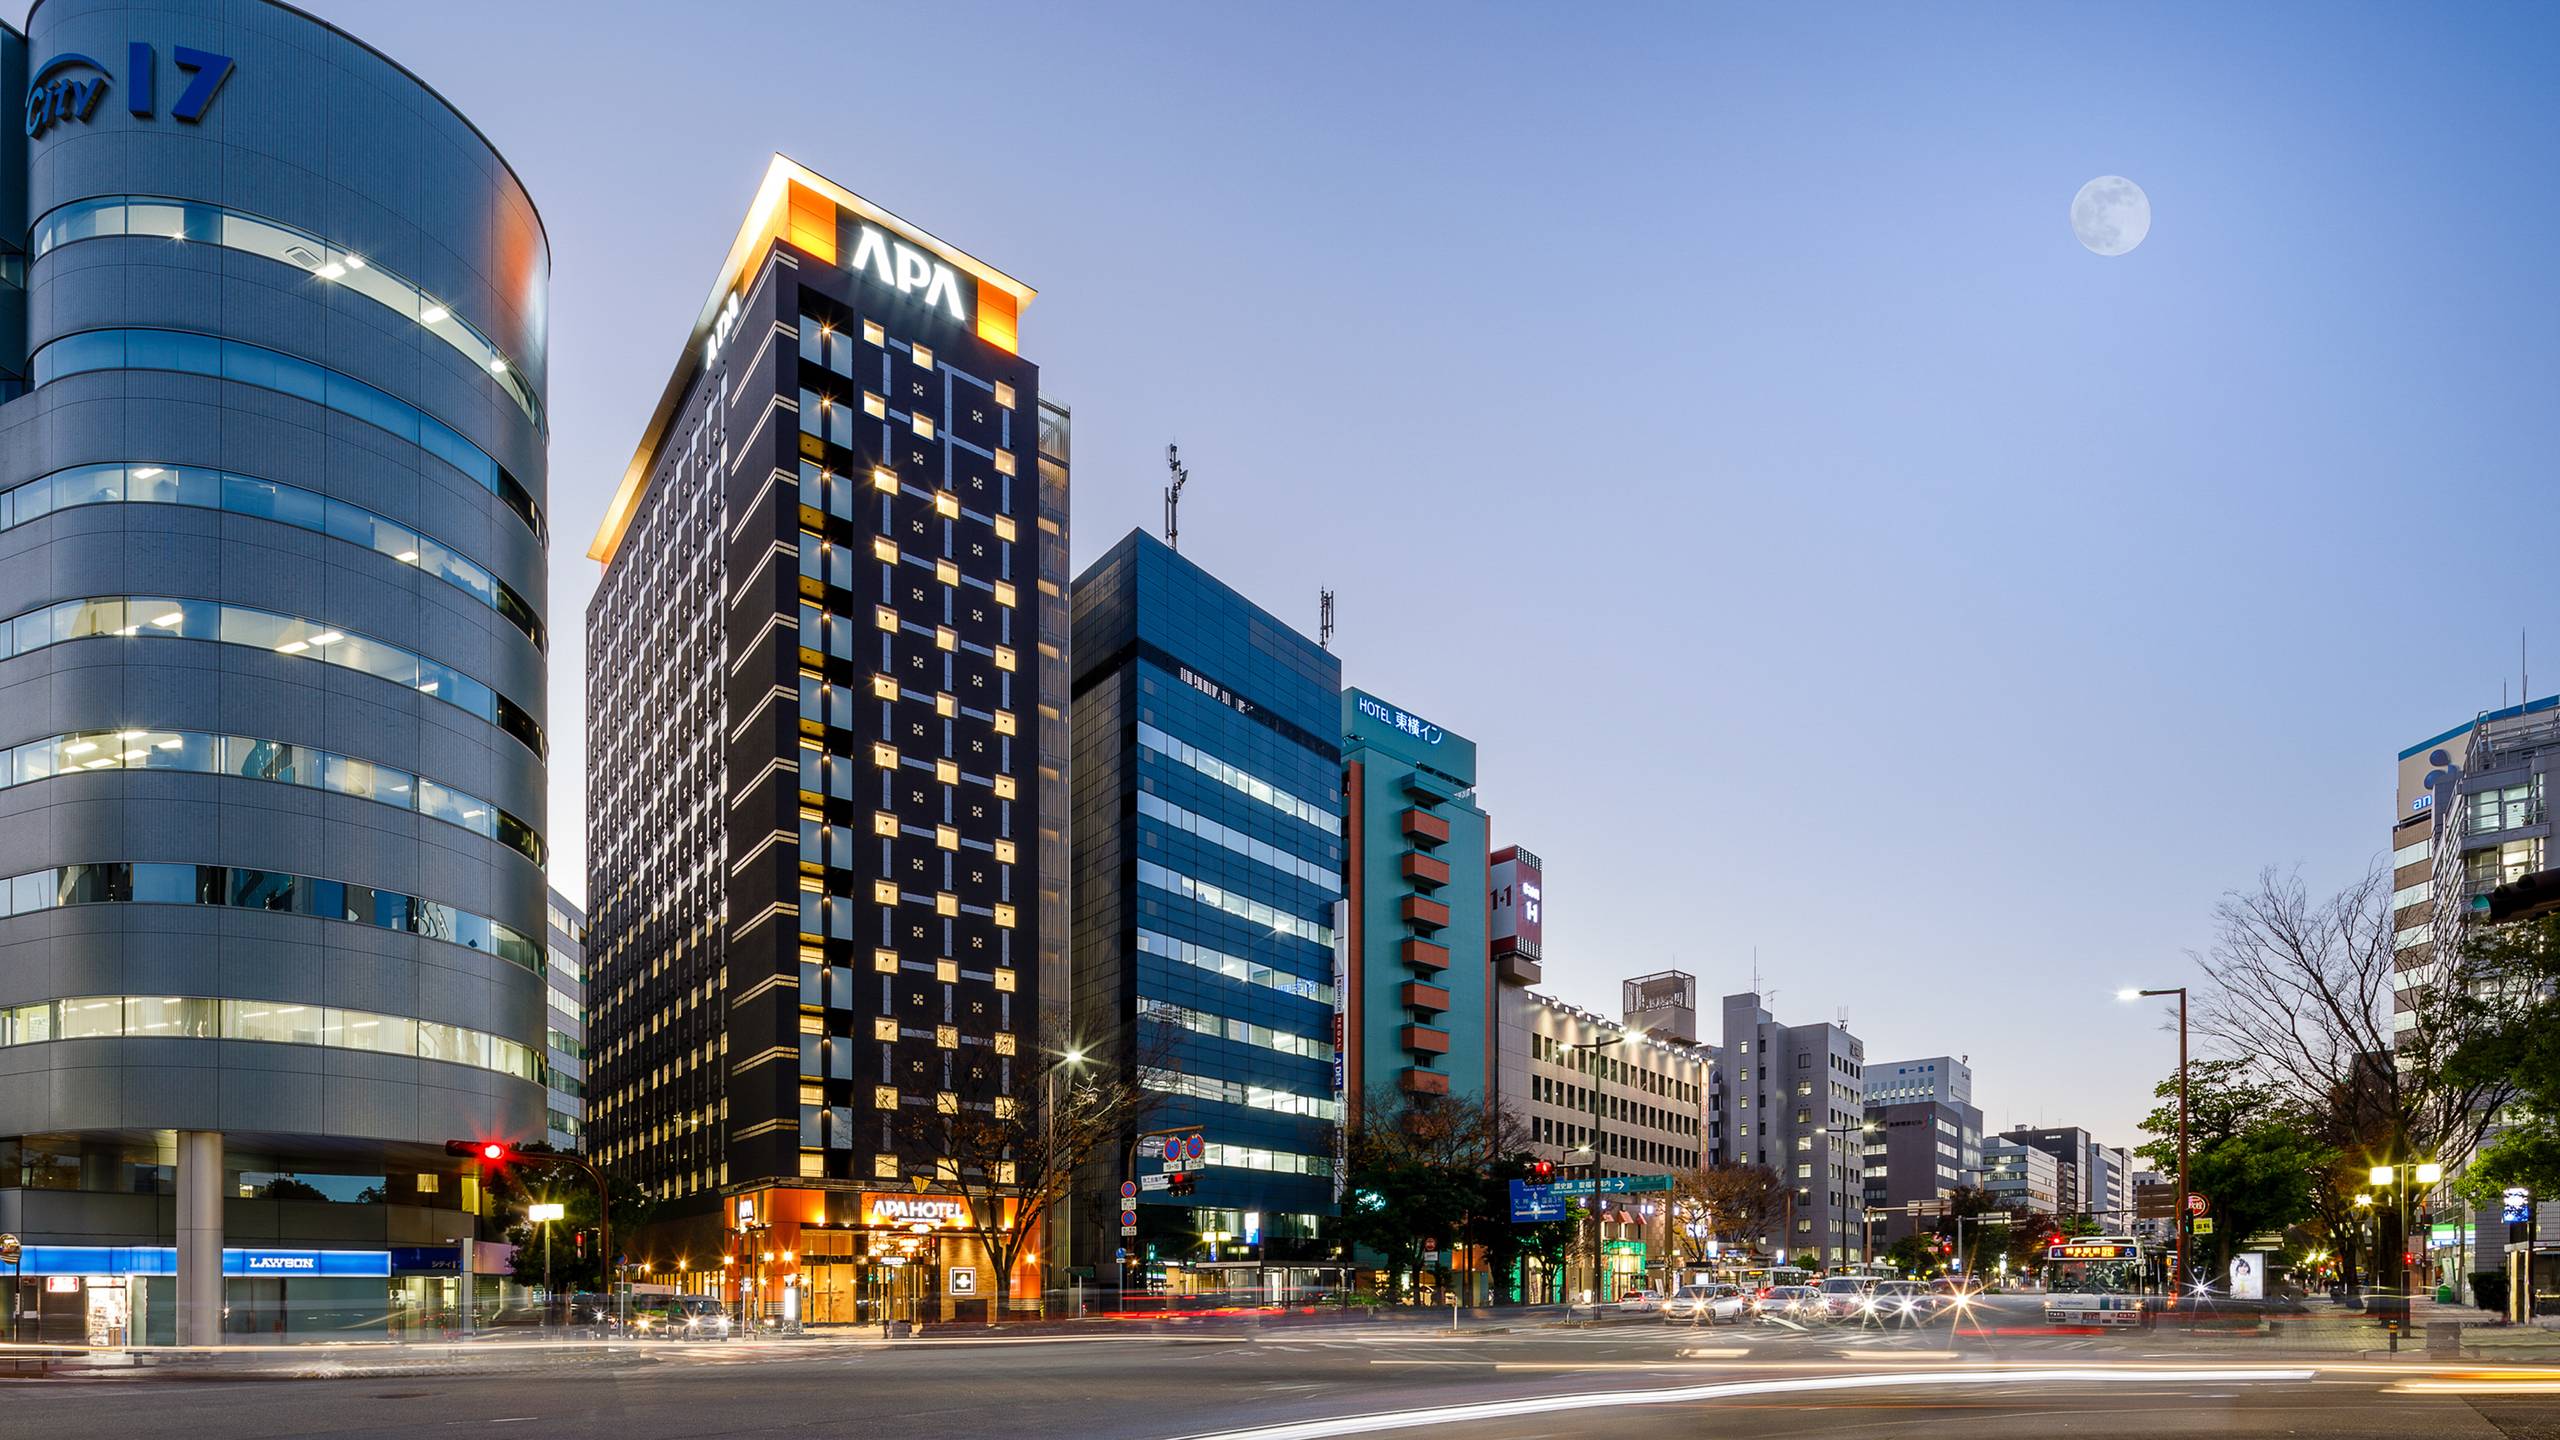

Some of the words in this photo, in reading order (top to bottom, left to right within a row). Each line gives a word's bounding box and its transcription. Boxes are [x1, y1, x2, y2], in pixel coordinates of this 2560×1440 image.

[26, 77, 107, 141] City
[128, 41, 235, 123] 17
[852, 225, 966, 321] APA
[1359, 697, 1392, 725] HOTEL
[1395, 711, 1442, 744] 東横イン
[872, 1200, 909, 1217] APA
[909, 1201, 964, 1219] HOTEL
[249, 1257, 314, 1268] LAWSON
